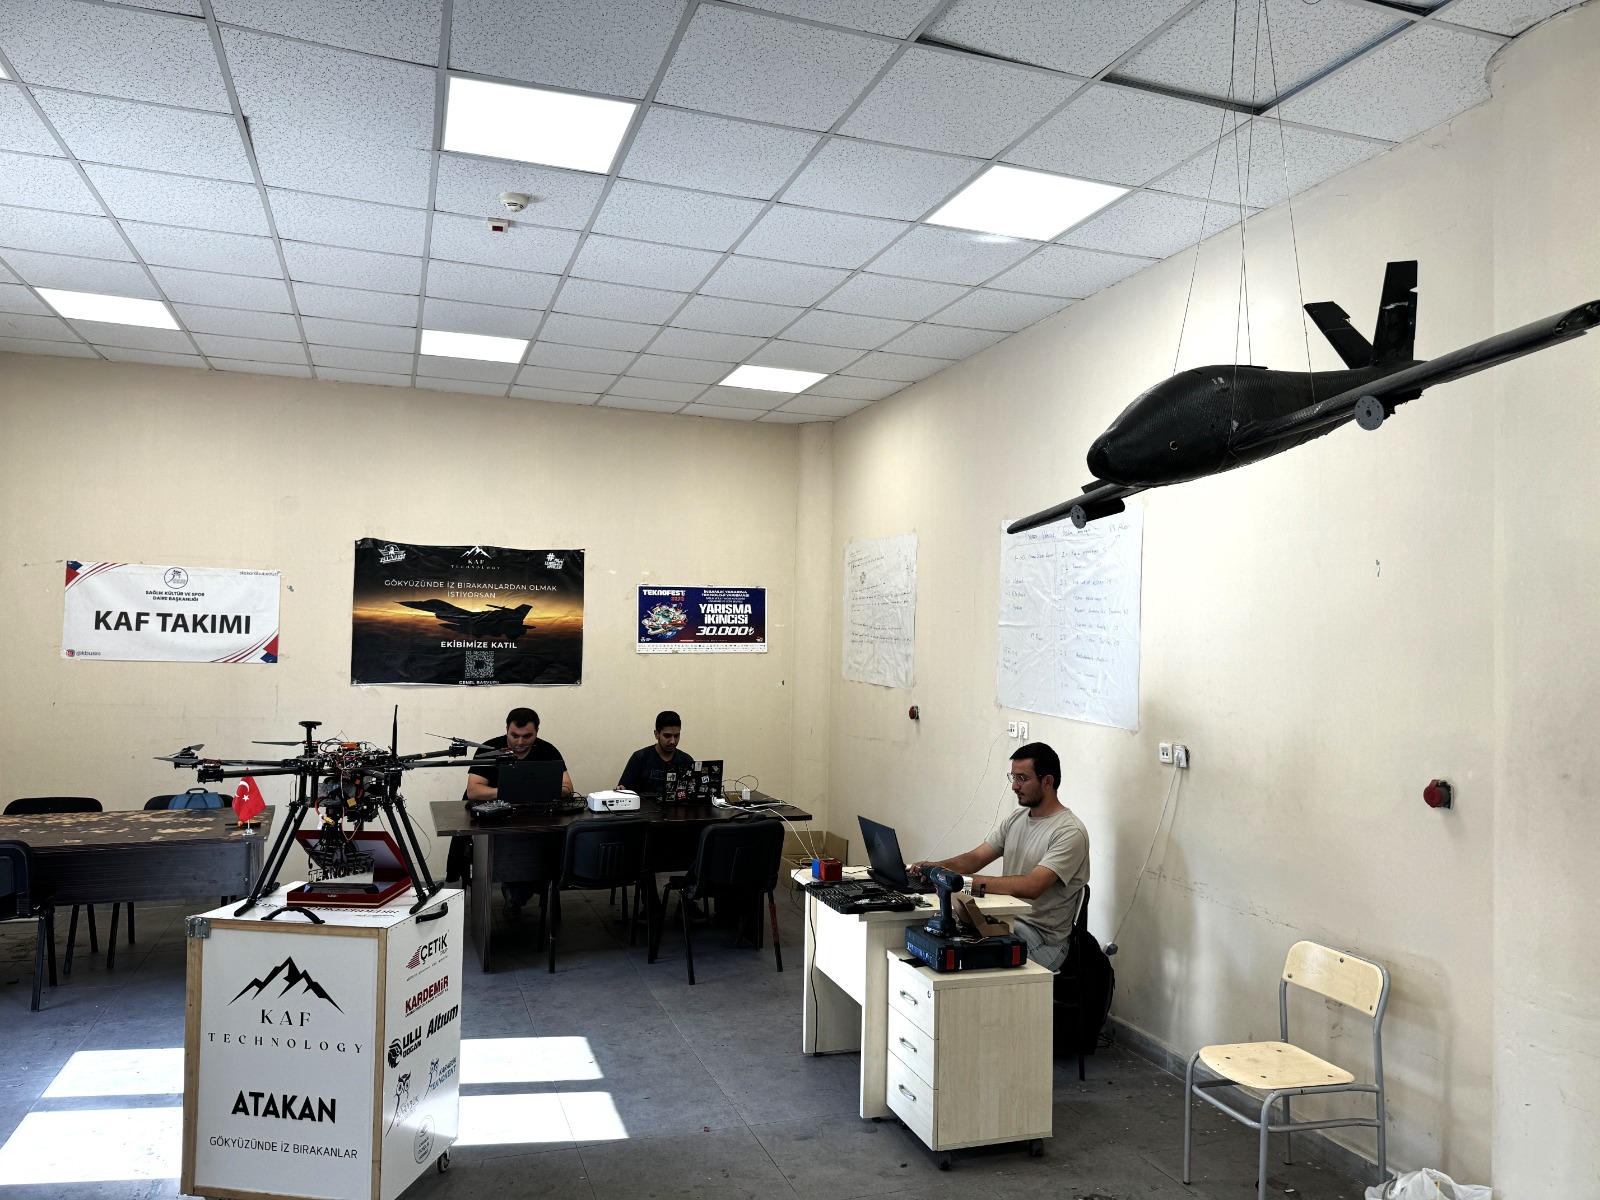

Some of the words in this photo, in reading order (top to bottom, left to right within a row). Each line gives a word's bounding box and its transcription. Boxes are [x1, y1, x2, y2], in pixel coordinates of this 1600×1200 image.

[384, 579, 444, 588] GÖKYÜZÜNDE
[457, 583, 527, 591] BIRAKANLARDAN
[529, 584, 557, 592] OLMAK
[447, 590, 496, 599] İSTİYORSAN
[642, 589, 686, 597] TEKNOFEST
[698, 603, 753, 615] YARIŞMA
[704, 614, 749, 624] İKİNCİSİ
[94, 610, 150, 632] KAF
[156, 612, 251, 634] TAKIMI
[440, 639, 489, 649] EKİBİMİZE
[491, 641, 518, 649] KATIL
[420, 932, 448, 965] ÇETİK
[405, 974, 449, 1014] KARDEMİR
[260, 1008, 312, 1027] KAF
[207, 1031, 364, 1053] TECHNOLOGY
[402, 1025, 422, 1049] ULU
[231, 1090, 337, 1124] ATAKAN
[209, 1135, 278, 1152] GÖKYÜZÜNDE
[280, 1140, 290, 1153] İZ
[292, 1143, 358, 1159] BIRAKANLAR
